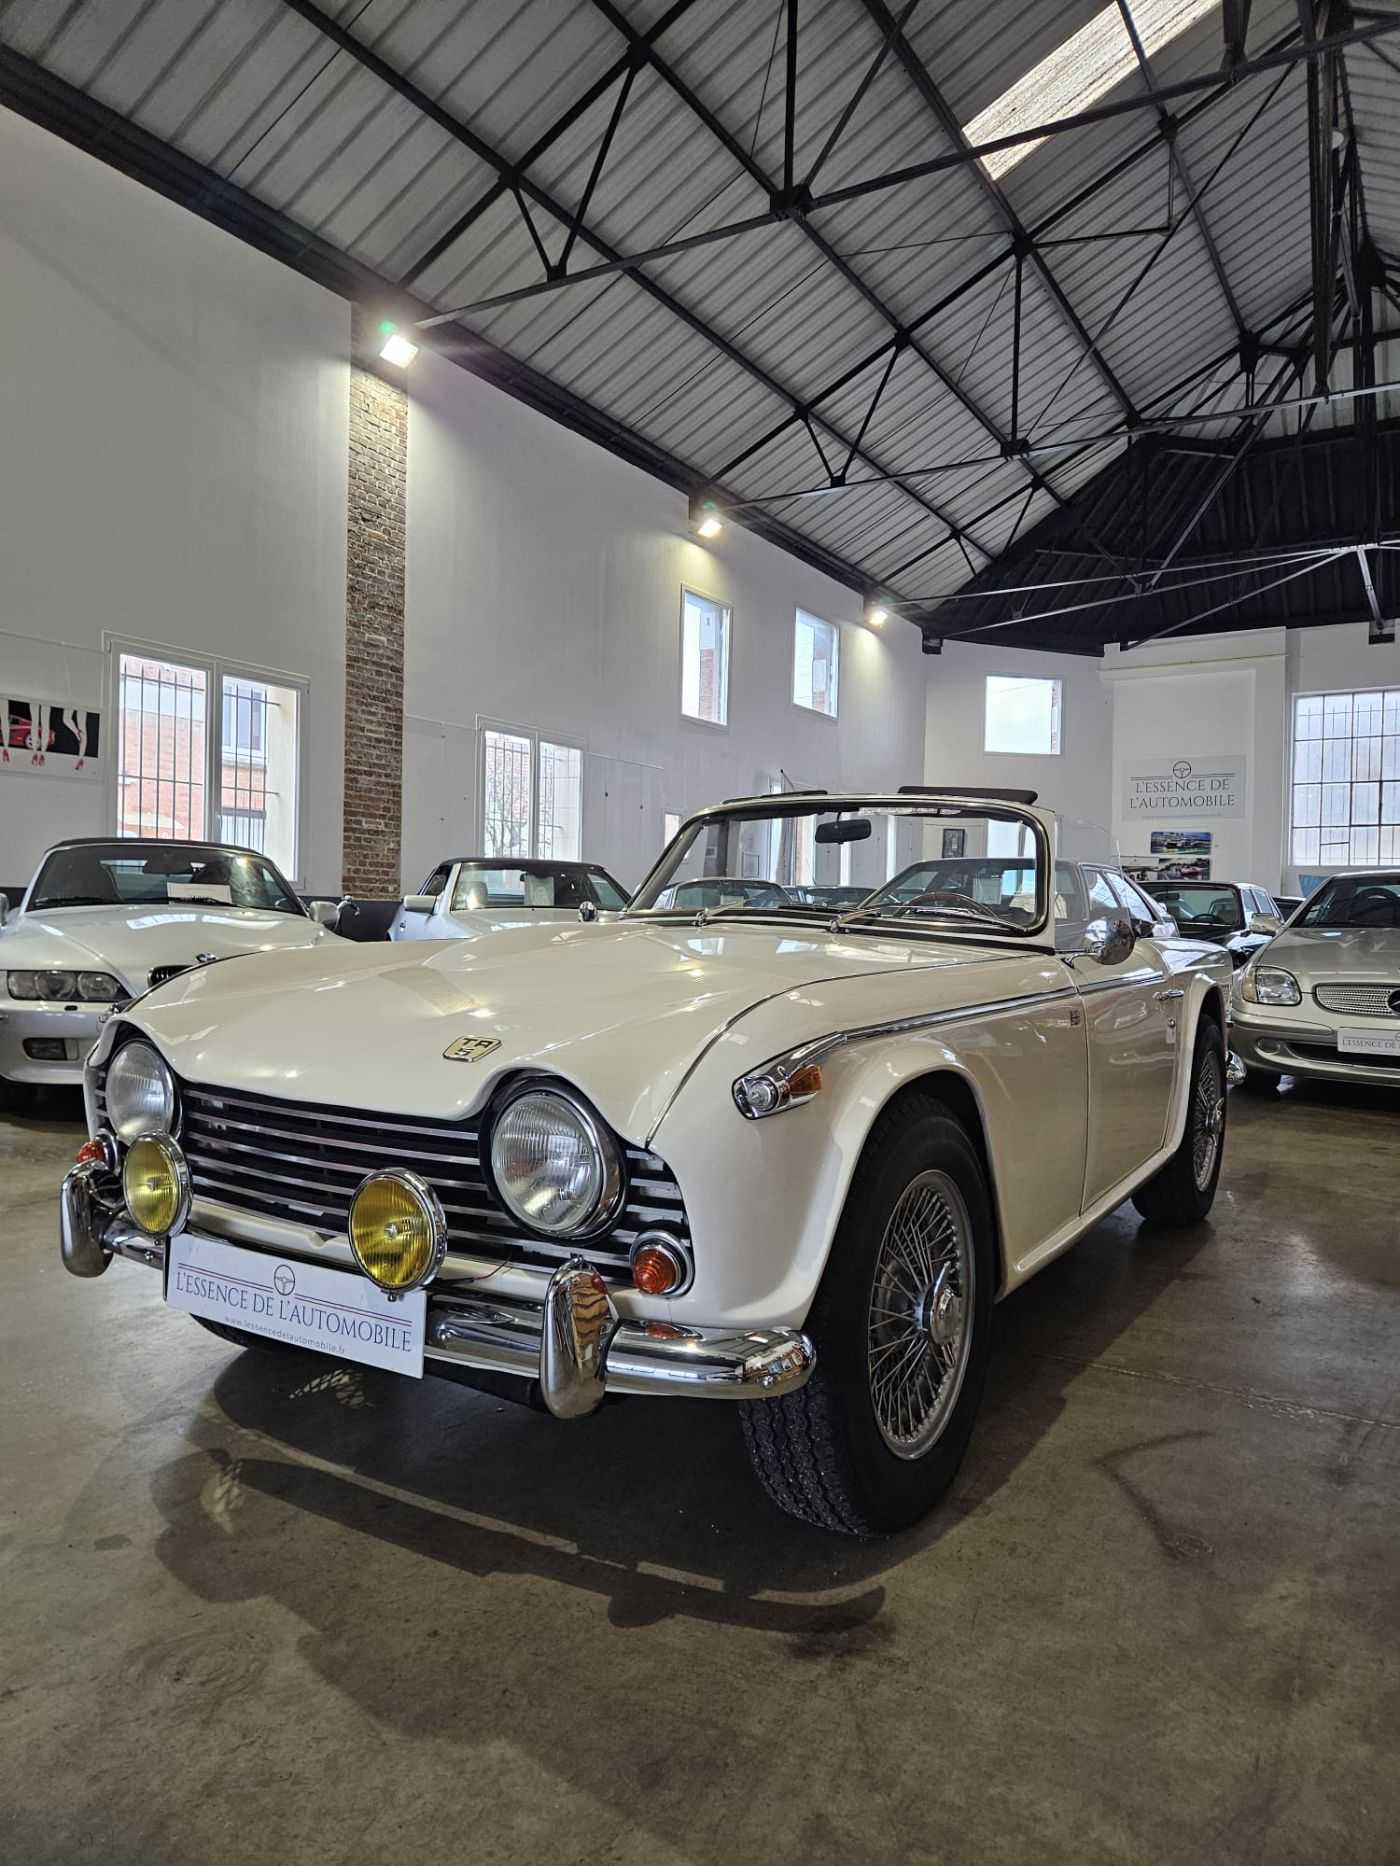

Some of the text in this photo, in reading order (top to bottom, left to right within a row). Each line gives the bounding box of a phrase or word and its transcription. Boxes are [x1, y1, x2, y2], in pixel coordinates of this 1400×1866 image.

[1136, 778, 1230, 794] L'ESSENCE DE
[1130, 794, 1235, 809] L'AUTOMOBILE
[176, 1271, 413, 1352] L'ESSENCE DE L'AUTOMOBILE
